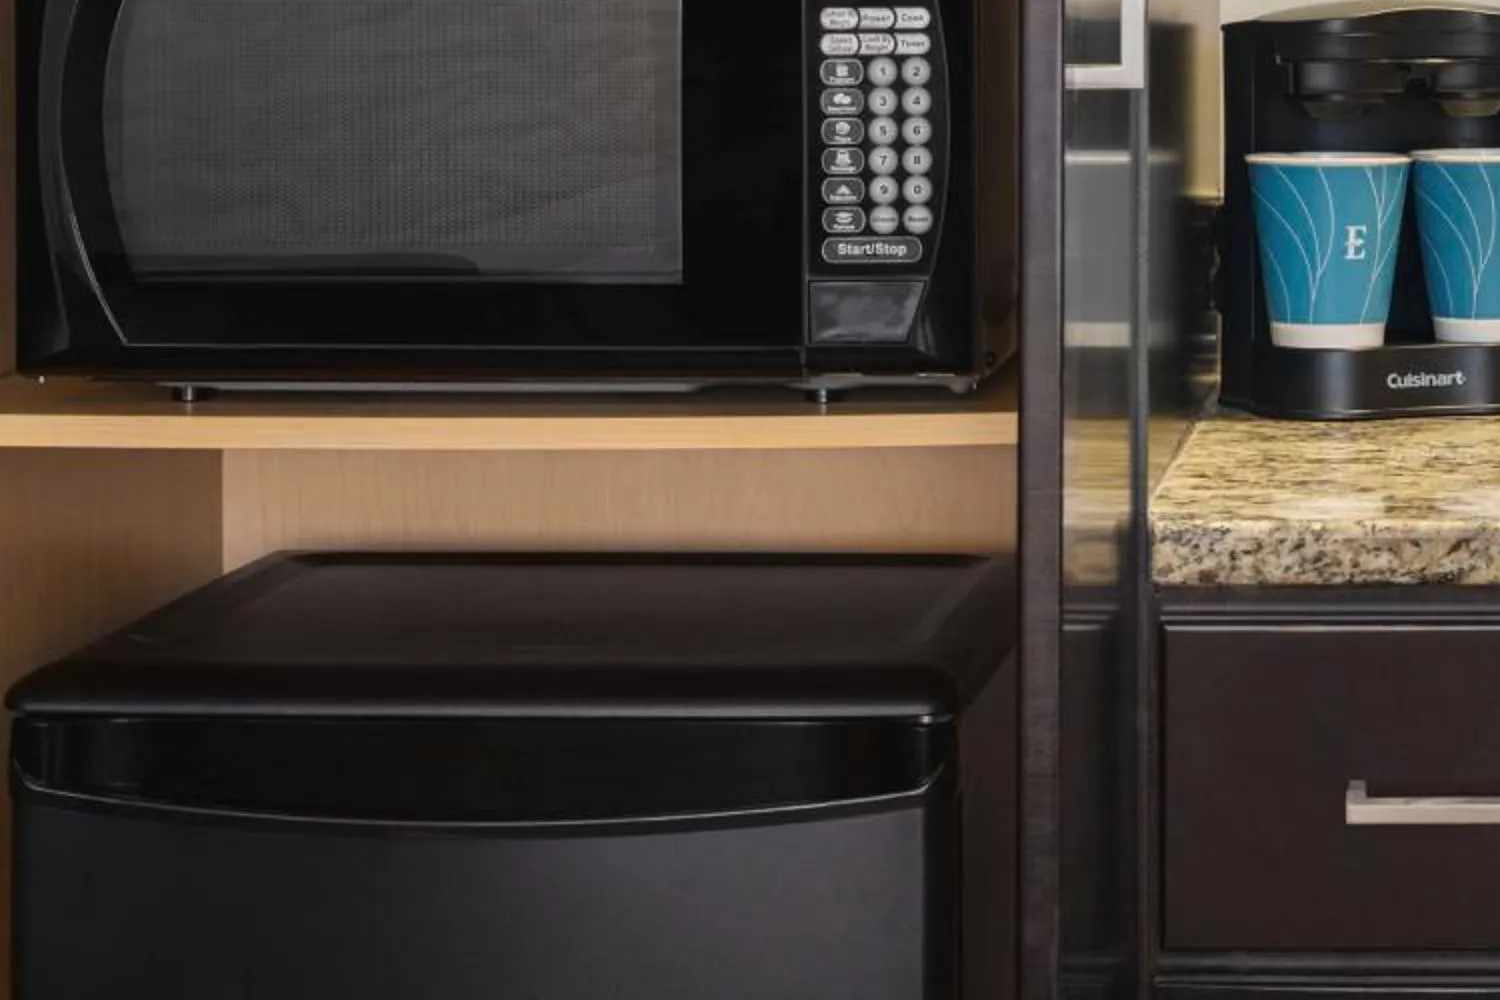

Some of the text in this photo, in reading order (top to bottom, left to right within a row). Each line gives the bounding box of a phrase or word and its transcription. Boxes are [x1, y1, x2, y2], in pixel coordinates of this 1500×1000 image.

[901, 13, 924, 22] Cook
[912, 66, 921, 76] 2
[879, 96, 887, 106] 3
[912, 96, 921, 105] 4
[879, 125, 887, 136] 5
[913, 125, 921, 136] 6
[879, 155, 887, 165] 7
[879, 184, 888, 194] 9
[1344, 225, 1368, 261] E
[837, 242, 908, 257] Start/Stop
[1386, 370, 1466, 390] Cuisinart
